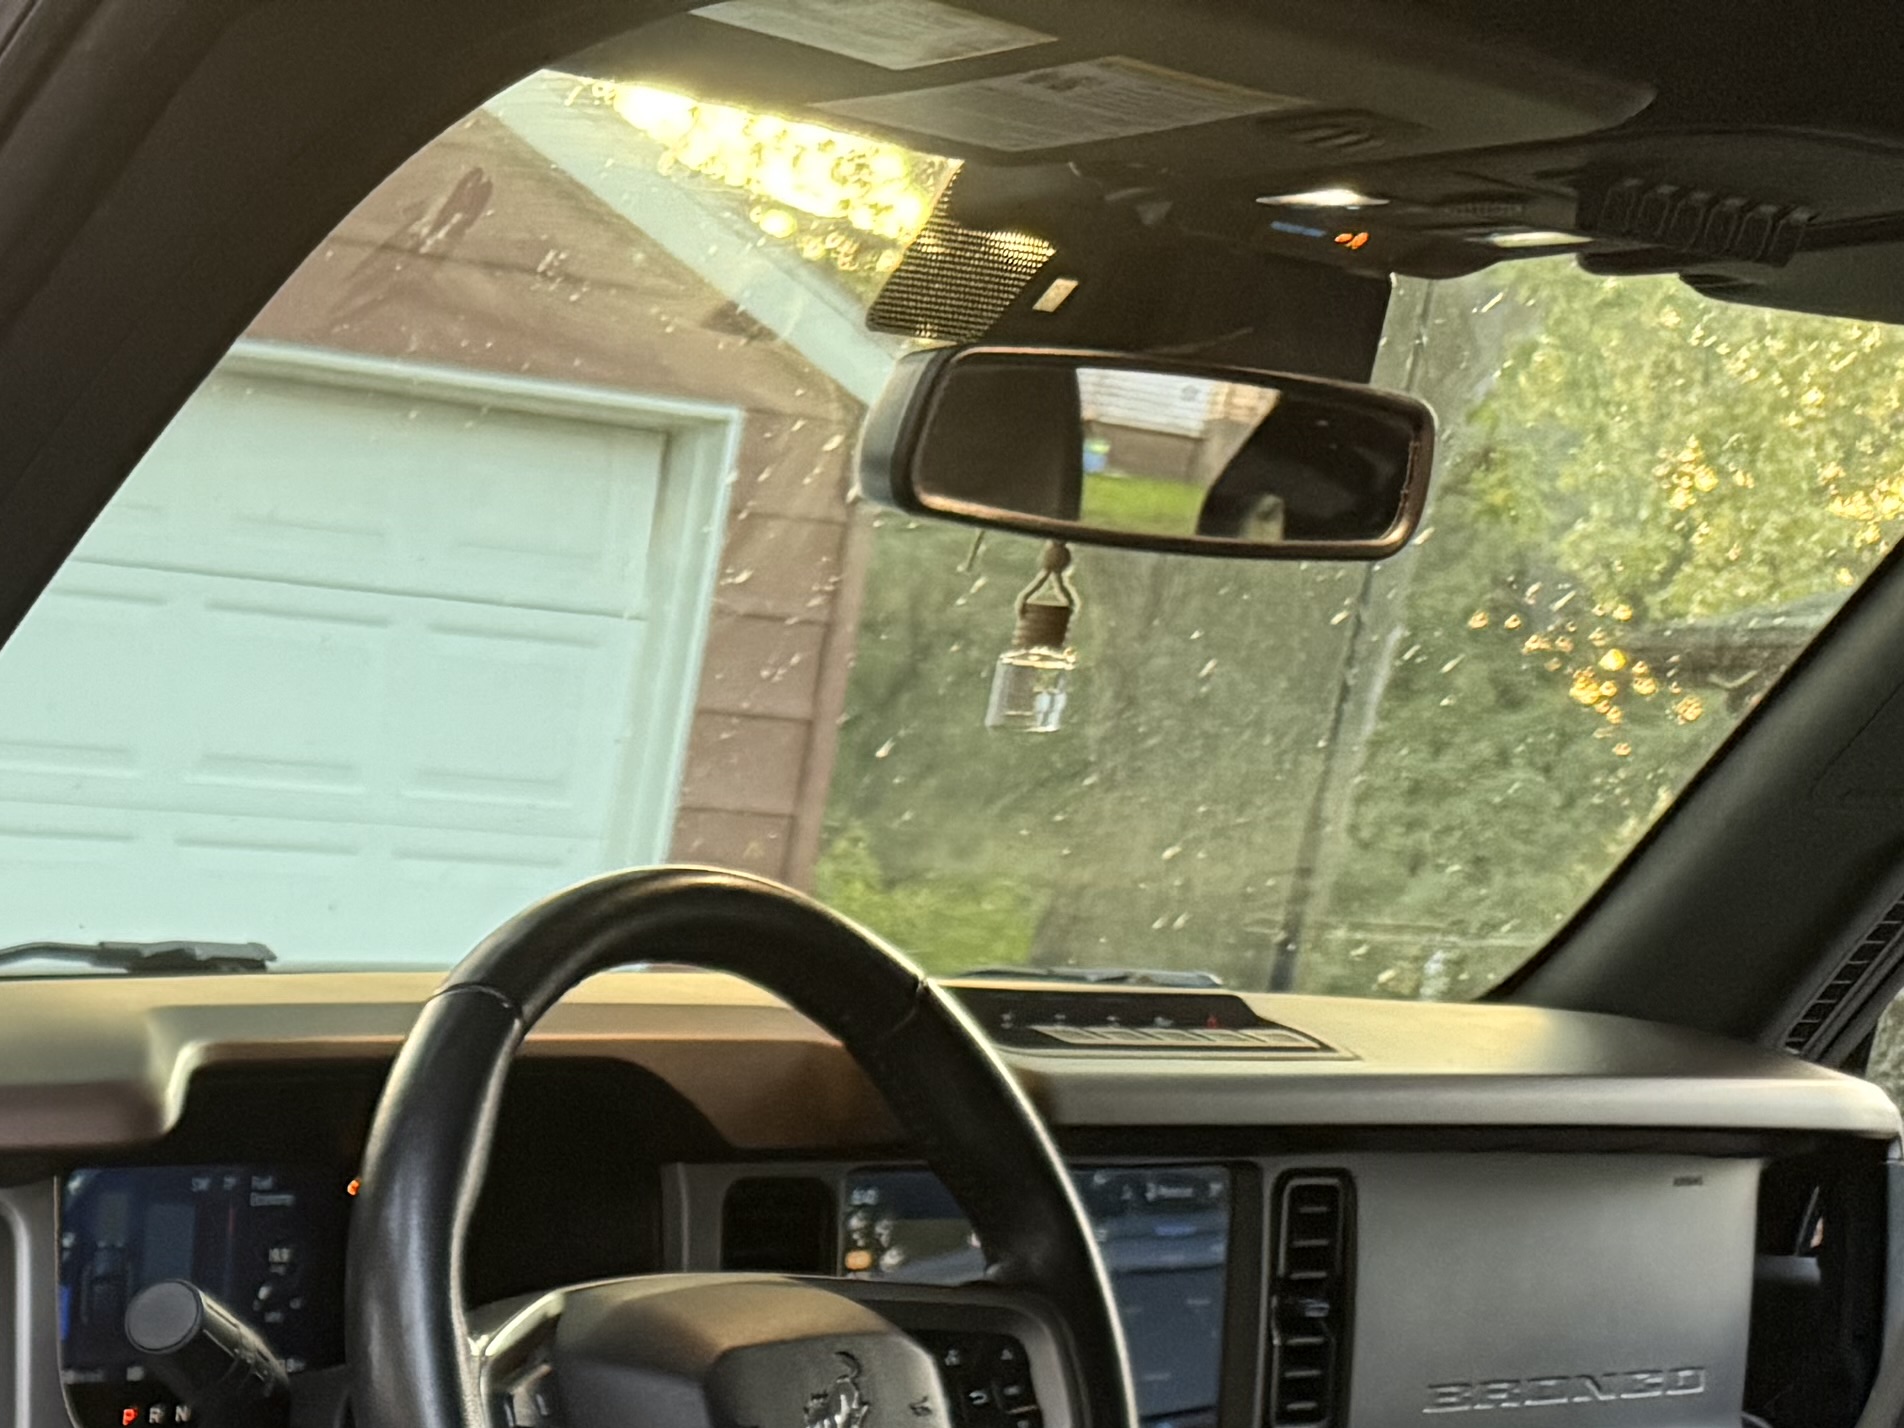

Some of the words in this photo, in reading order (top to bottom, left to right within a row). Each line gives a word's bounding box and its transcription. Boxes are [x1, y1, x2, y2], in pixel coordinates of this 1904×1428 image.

[1422, 1366, 1707, 1413] BRONCO
[122, 1406, 138, 1426] P
[148, 1405, 164, 1424] R
[175, 1404, 191, 1423] N
